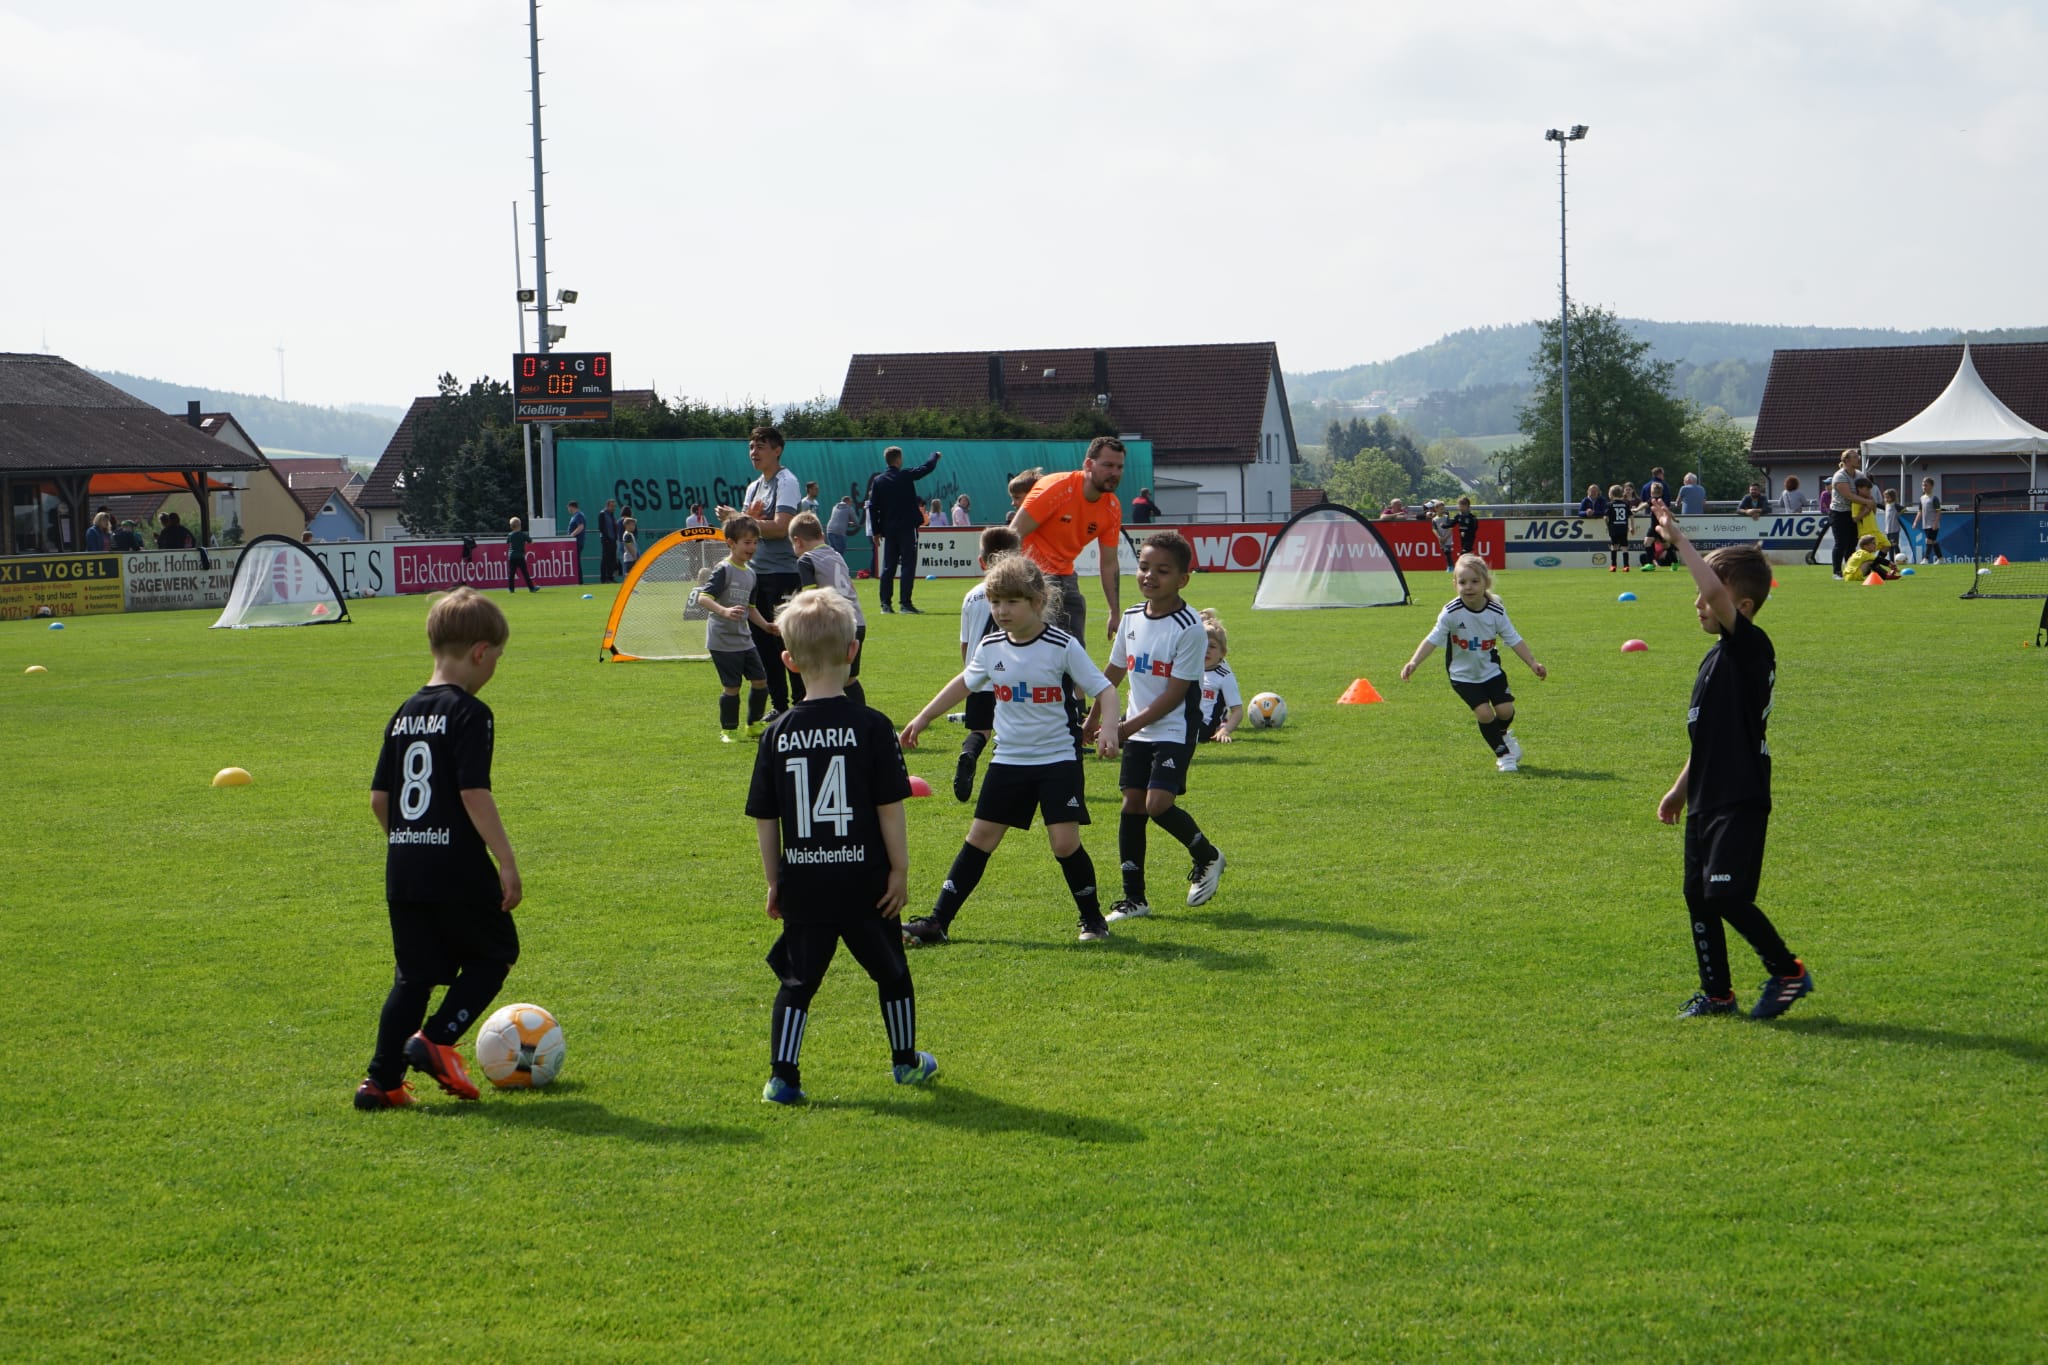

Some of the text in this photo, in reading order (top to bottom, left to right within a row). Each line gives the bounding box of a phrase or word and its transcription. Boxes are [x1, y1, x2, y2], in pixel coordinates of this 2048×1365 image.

[522, 357, 536, 377] 0
[593, 356, 607, 377] 0
[582, 385, 602, 393] min.
[518, 404, 567, 417] Kießling
[614, 477, 750, 512] GSS Bau Gm
[1614, 507, 1627, 521] 13
[915, 540, 956, 550] rweg 2
[42, 561, 107, 579] VOGEL
[127, 556, 161, 574] Gebr.
[524, 550, 576, 579] GmbH
[921, 557, 973, 567] Mistelgau
[130, 576, 199, 594] SÄGEWERK
[687, 589, 699, 607] 9
[993, 681, 1063, 704] ROLLER
[391, 714, 447, 737] BAVARIA
[777, 727, 858, 753] BAVARIA
[399, 740, 433, 821] 8
[785, 755, 854, 839] 14
[389, 826, 450, 845] aischenfeld
[785, 844, 865, 865] Waischenfeld
[1709, 873, 1732, 883] JAKO
